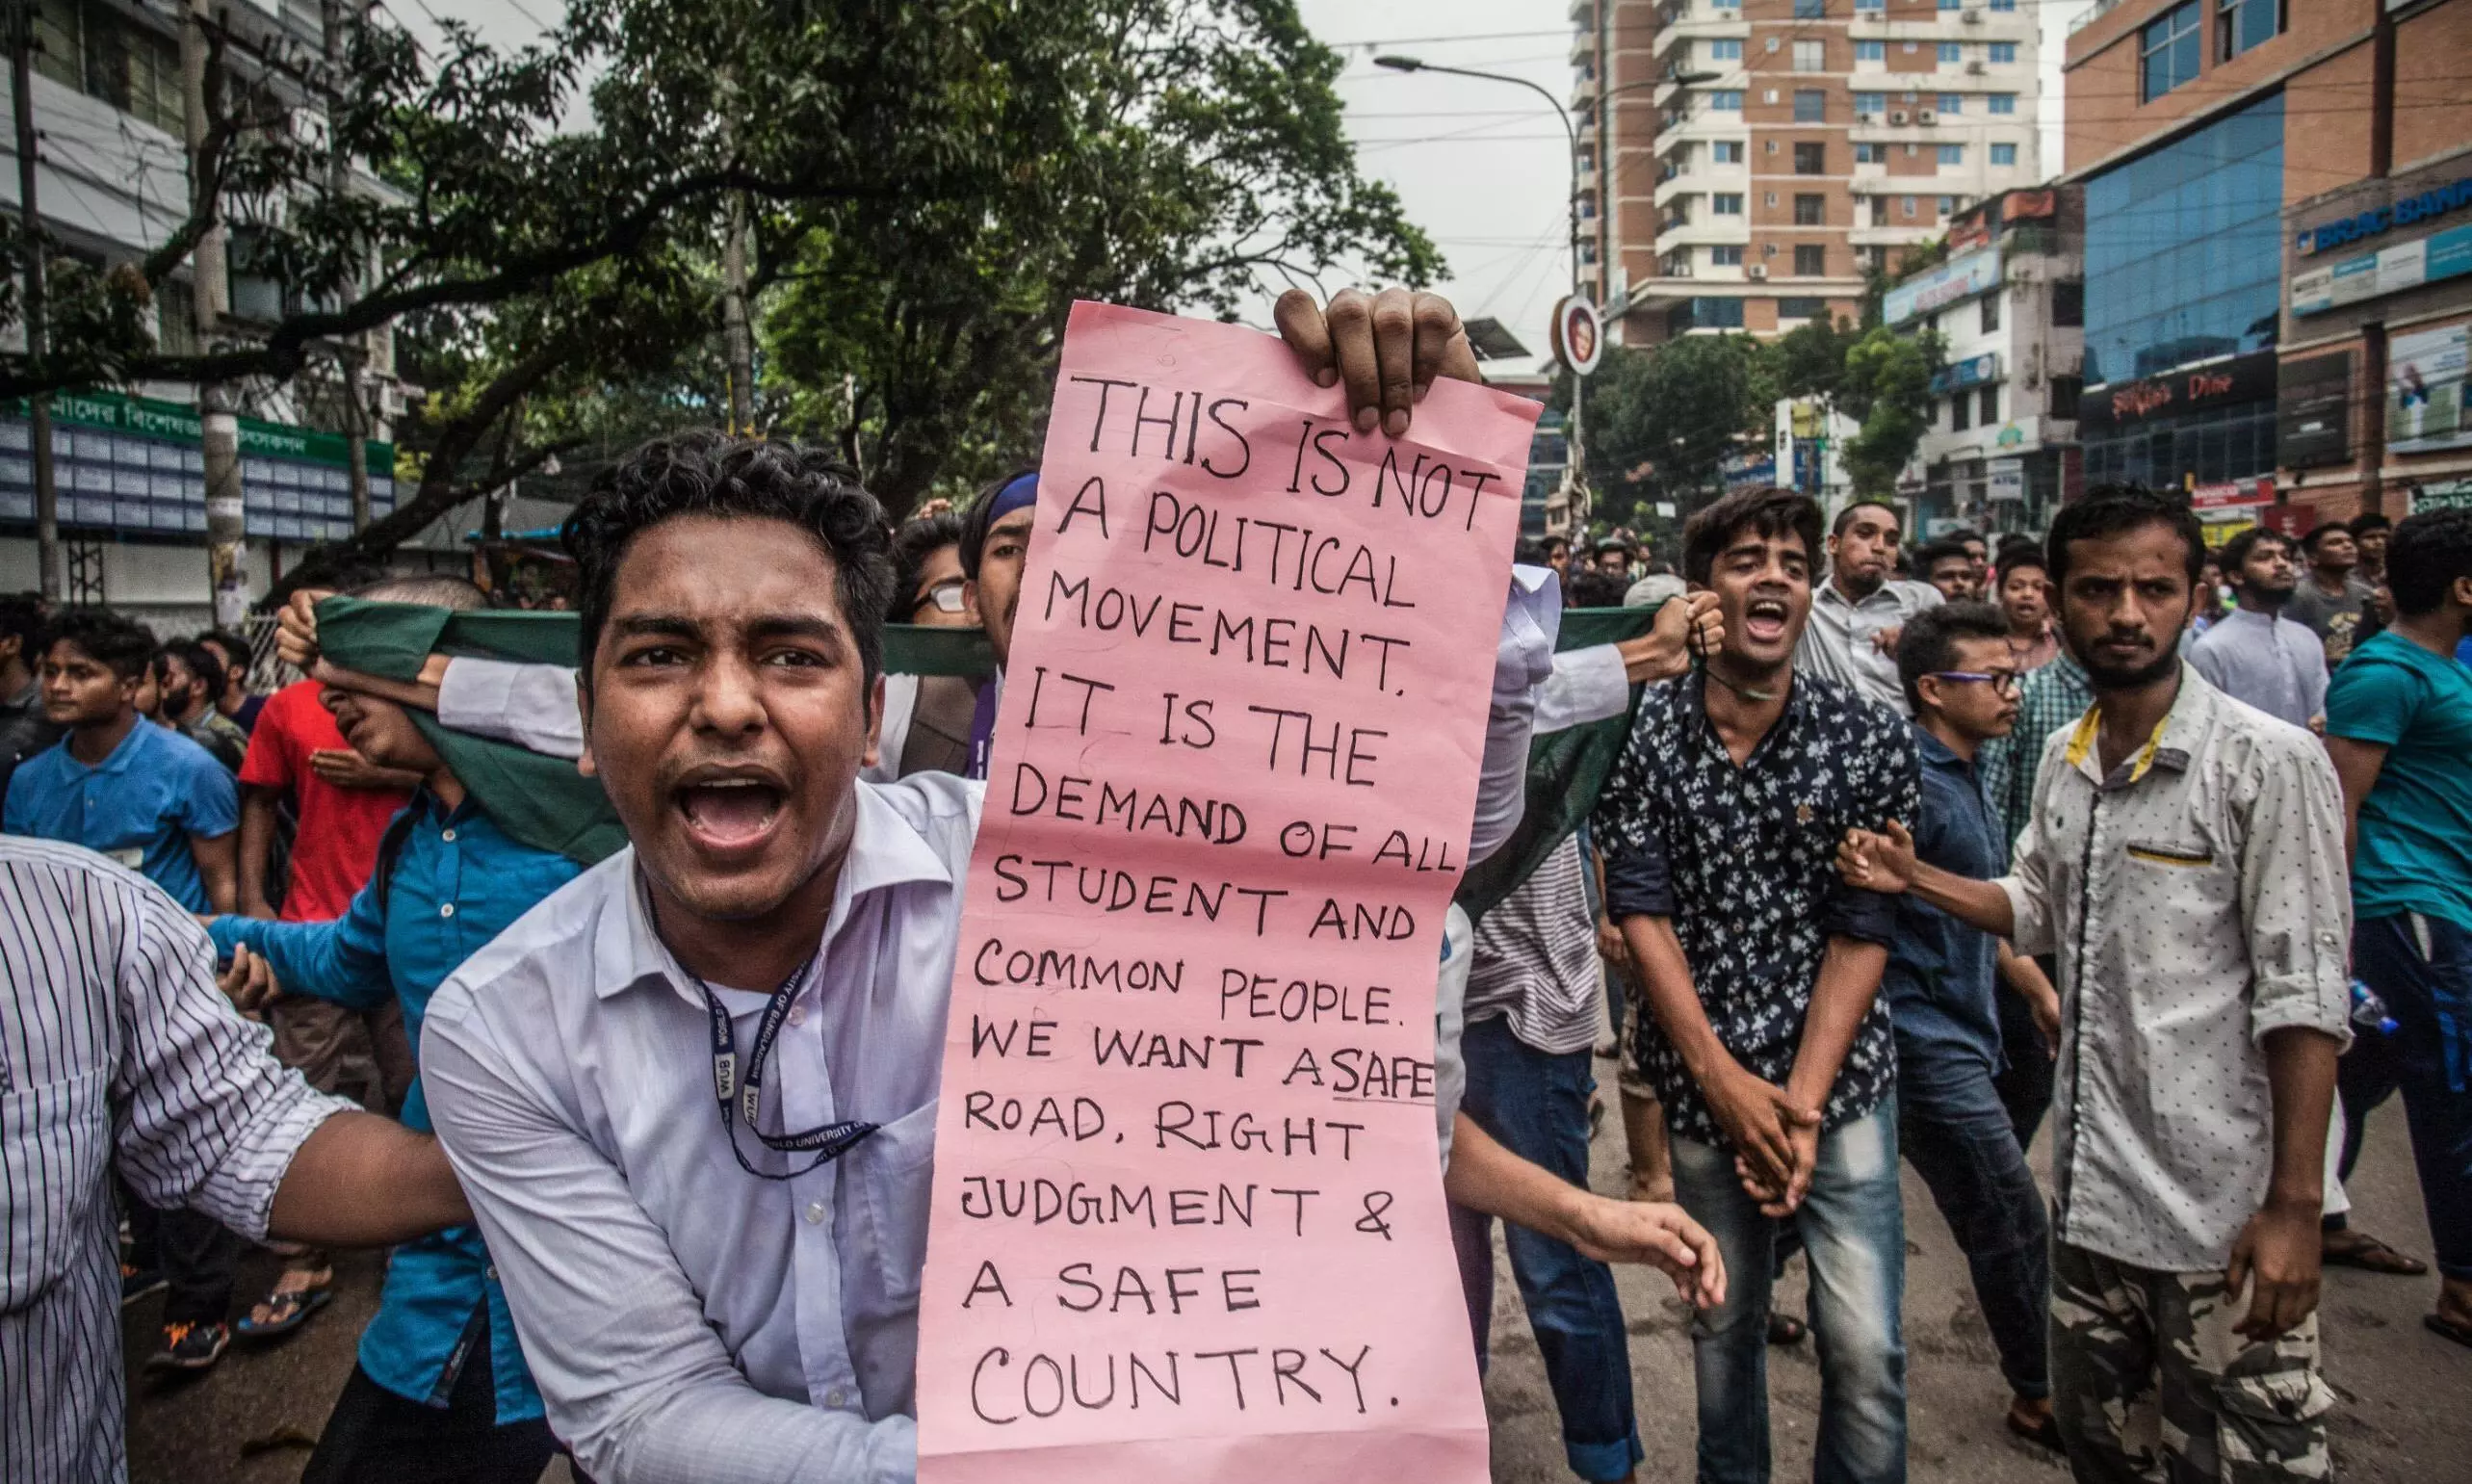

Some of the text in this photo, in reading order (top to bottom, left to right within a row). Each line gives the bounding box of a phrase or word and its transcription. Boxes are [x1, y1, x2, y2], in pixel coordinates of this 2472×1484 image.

[2315, 206, 2390, 252] BRAC
[1070, 375, 1502, 532] THIS IS NOT
[1056, 475, 1417, 608] A POLITICAL
[1044, 570, 1411, 697] MOVEMENT.
[1024, 666, 1389, 788] IT IS THE
[1010, 762, 1458, 873] DEMAND OF ALL
[993, 854, 1417, 942] STUDENT AND
[776, 995, 789, 1010] OF
[974, 937, 1404, 1027] COMMON PEOPLE.
[716, 1008, 730, 1047] WORLD
[751, 1009, 782, 1080] BANGLADESH
[970, 1013, 1058, 1059] WE
[1093, 1026, 1265, 1080] WANT
[719, 1059, 732, 1095] WUB
[795, 1125, 852, 1149] UNIVERSITY
[1155, 1100, 1366, 1160] RIGHT
[961, 1176, 1394, 1242] JUDGMENT &
[961, 1260, 1262, 1315] A SAFE
[971, 1344, 1400, 1425] COUNTRY.
